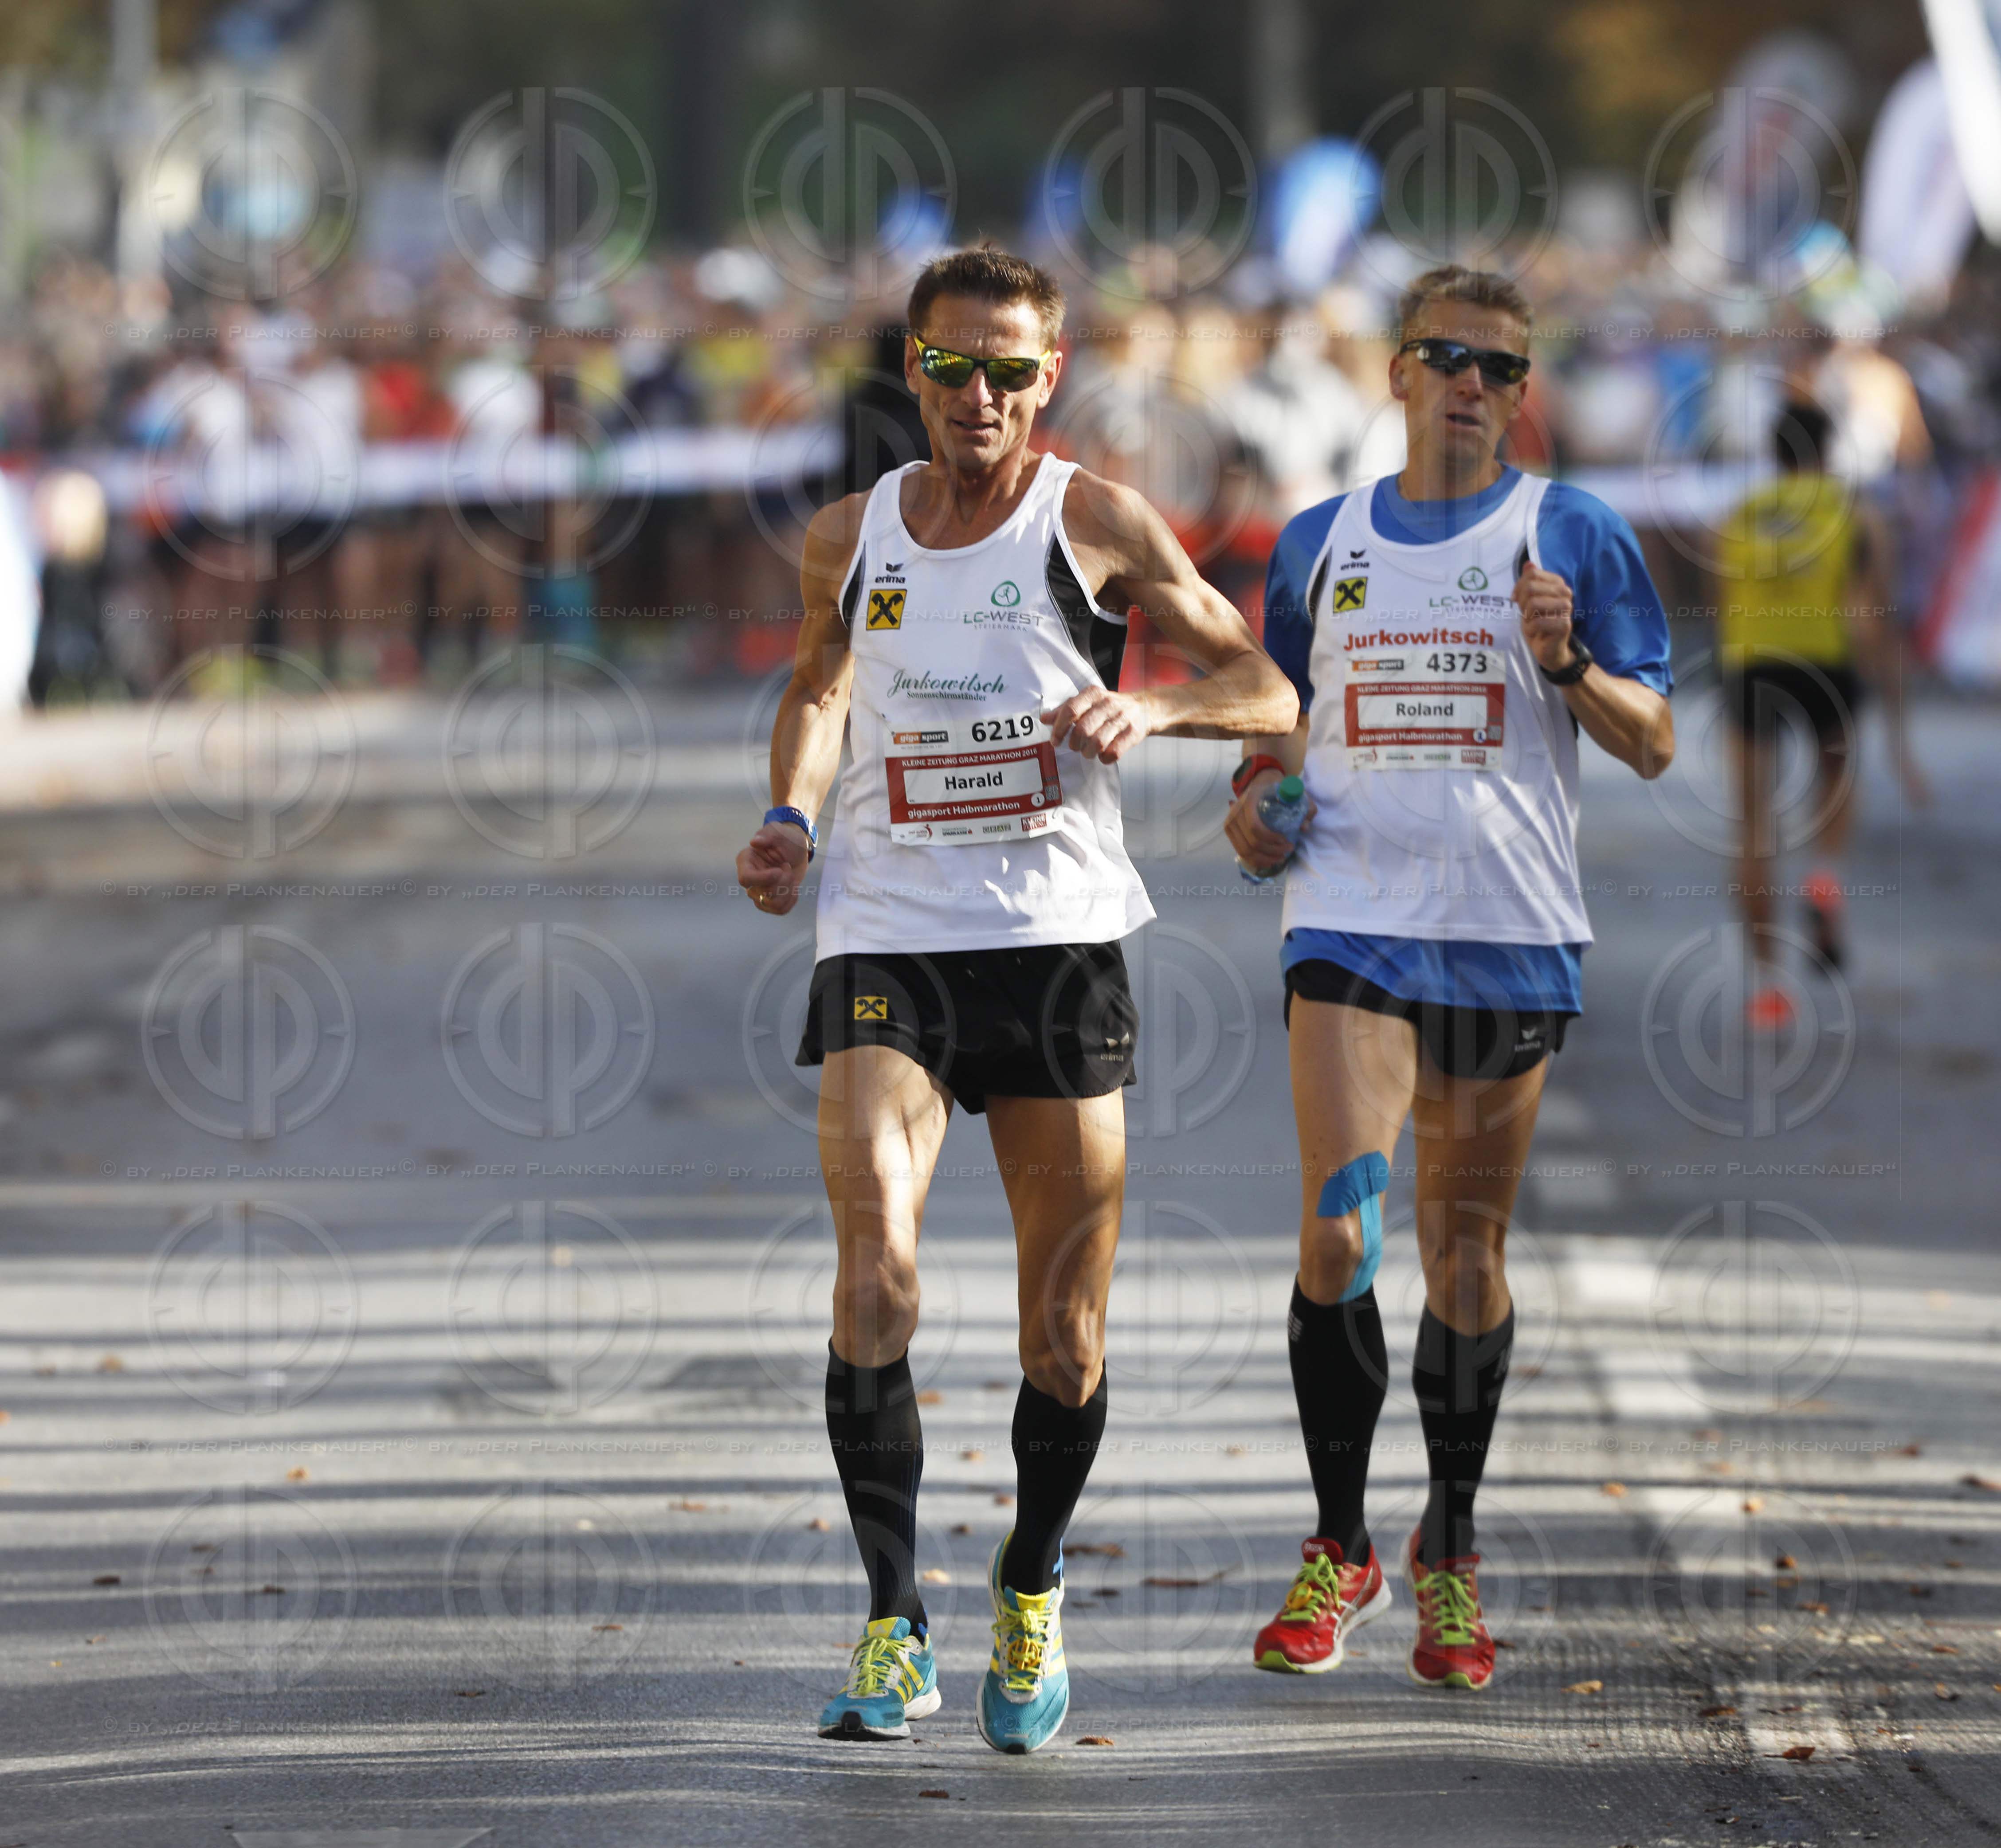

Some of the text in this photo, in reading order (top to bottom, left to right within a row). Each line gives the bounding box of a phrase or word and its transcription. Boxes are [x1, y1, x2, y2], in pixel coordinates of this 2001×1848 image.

[1341, 560, 1370, 571] erima
[875, 575, 905, 584] erima
[963, 610, 1044, 626] LC-WEST
[1343, 628, 1494, 651] Jurkowitsch
[1426, 653, 1487, 673] 4373
[887, 669, 1009, 699] Jurkowitsch
[907, 690, 987, 701] Sonnenschirmständer
[1396, 702, 1453, 716] Roland
[972, 715, 1034, 743] 6219
[1399, 731, 1463, 741] Halbmarathon
[902, 758, 926, 767] KLEINE
[927, 756, 957, 766] ZEITUNG
[959, 755, 978, 764] GRAZ
[979, 752, 1021, 762] MARATHON
[945, 771, 1004, 790] Harald
[907, 802, 1020, 819] gigasport Halbmarathon
